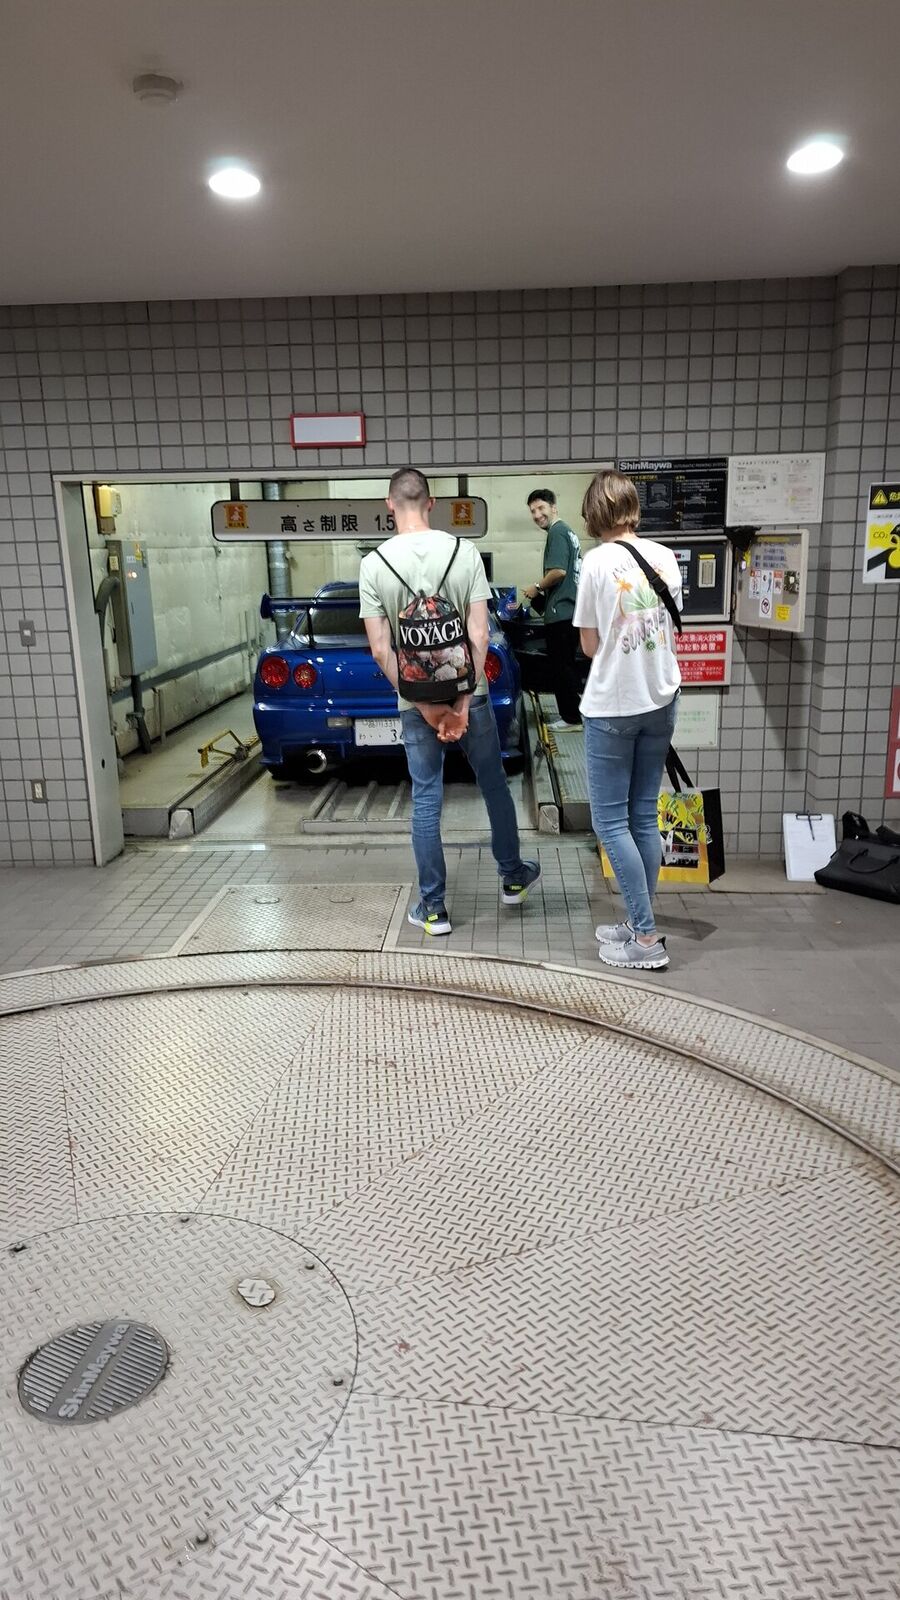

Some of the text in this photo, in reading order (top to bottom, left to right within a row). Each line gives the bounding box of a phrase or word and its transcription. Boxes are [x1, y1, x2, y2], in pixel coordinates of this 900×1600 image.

[620, 461, 672, 471] ShinMaywa
[280, 515, 359, 533] 高さ制限
[400, 617, 464, 647] VOYAGE
[58, 1324, 130, 1418] ShinMaywa
